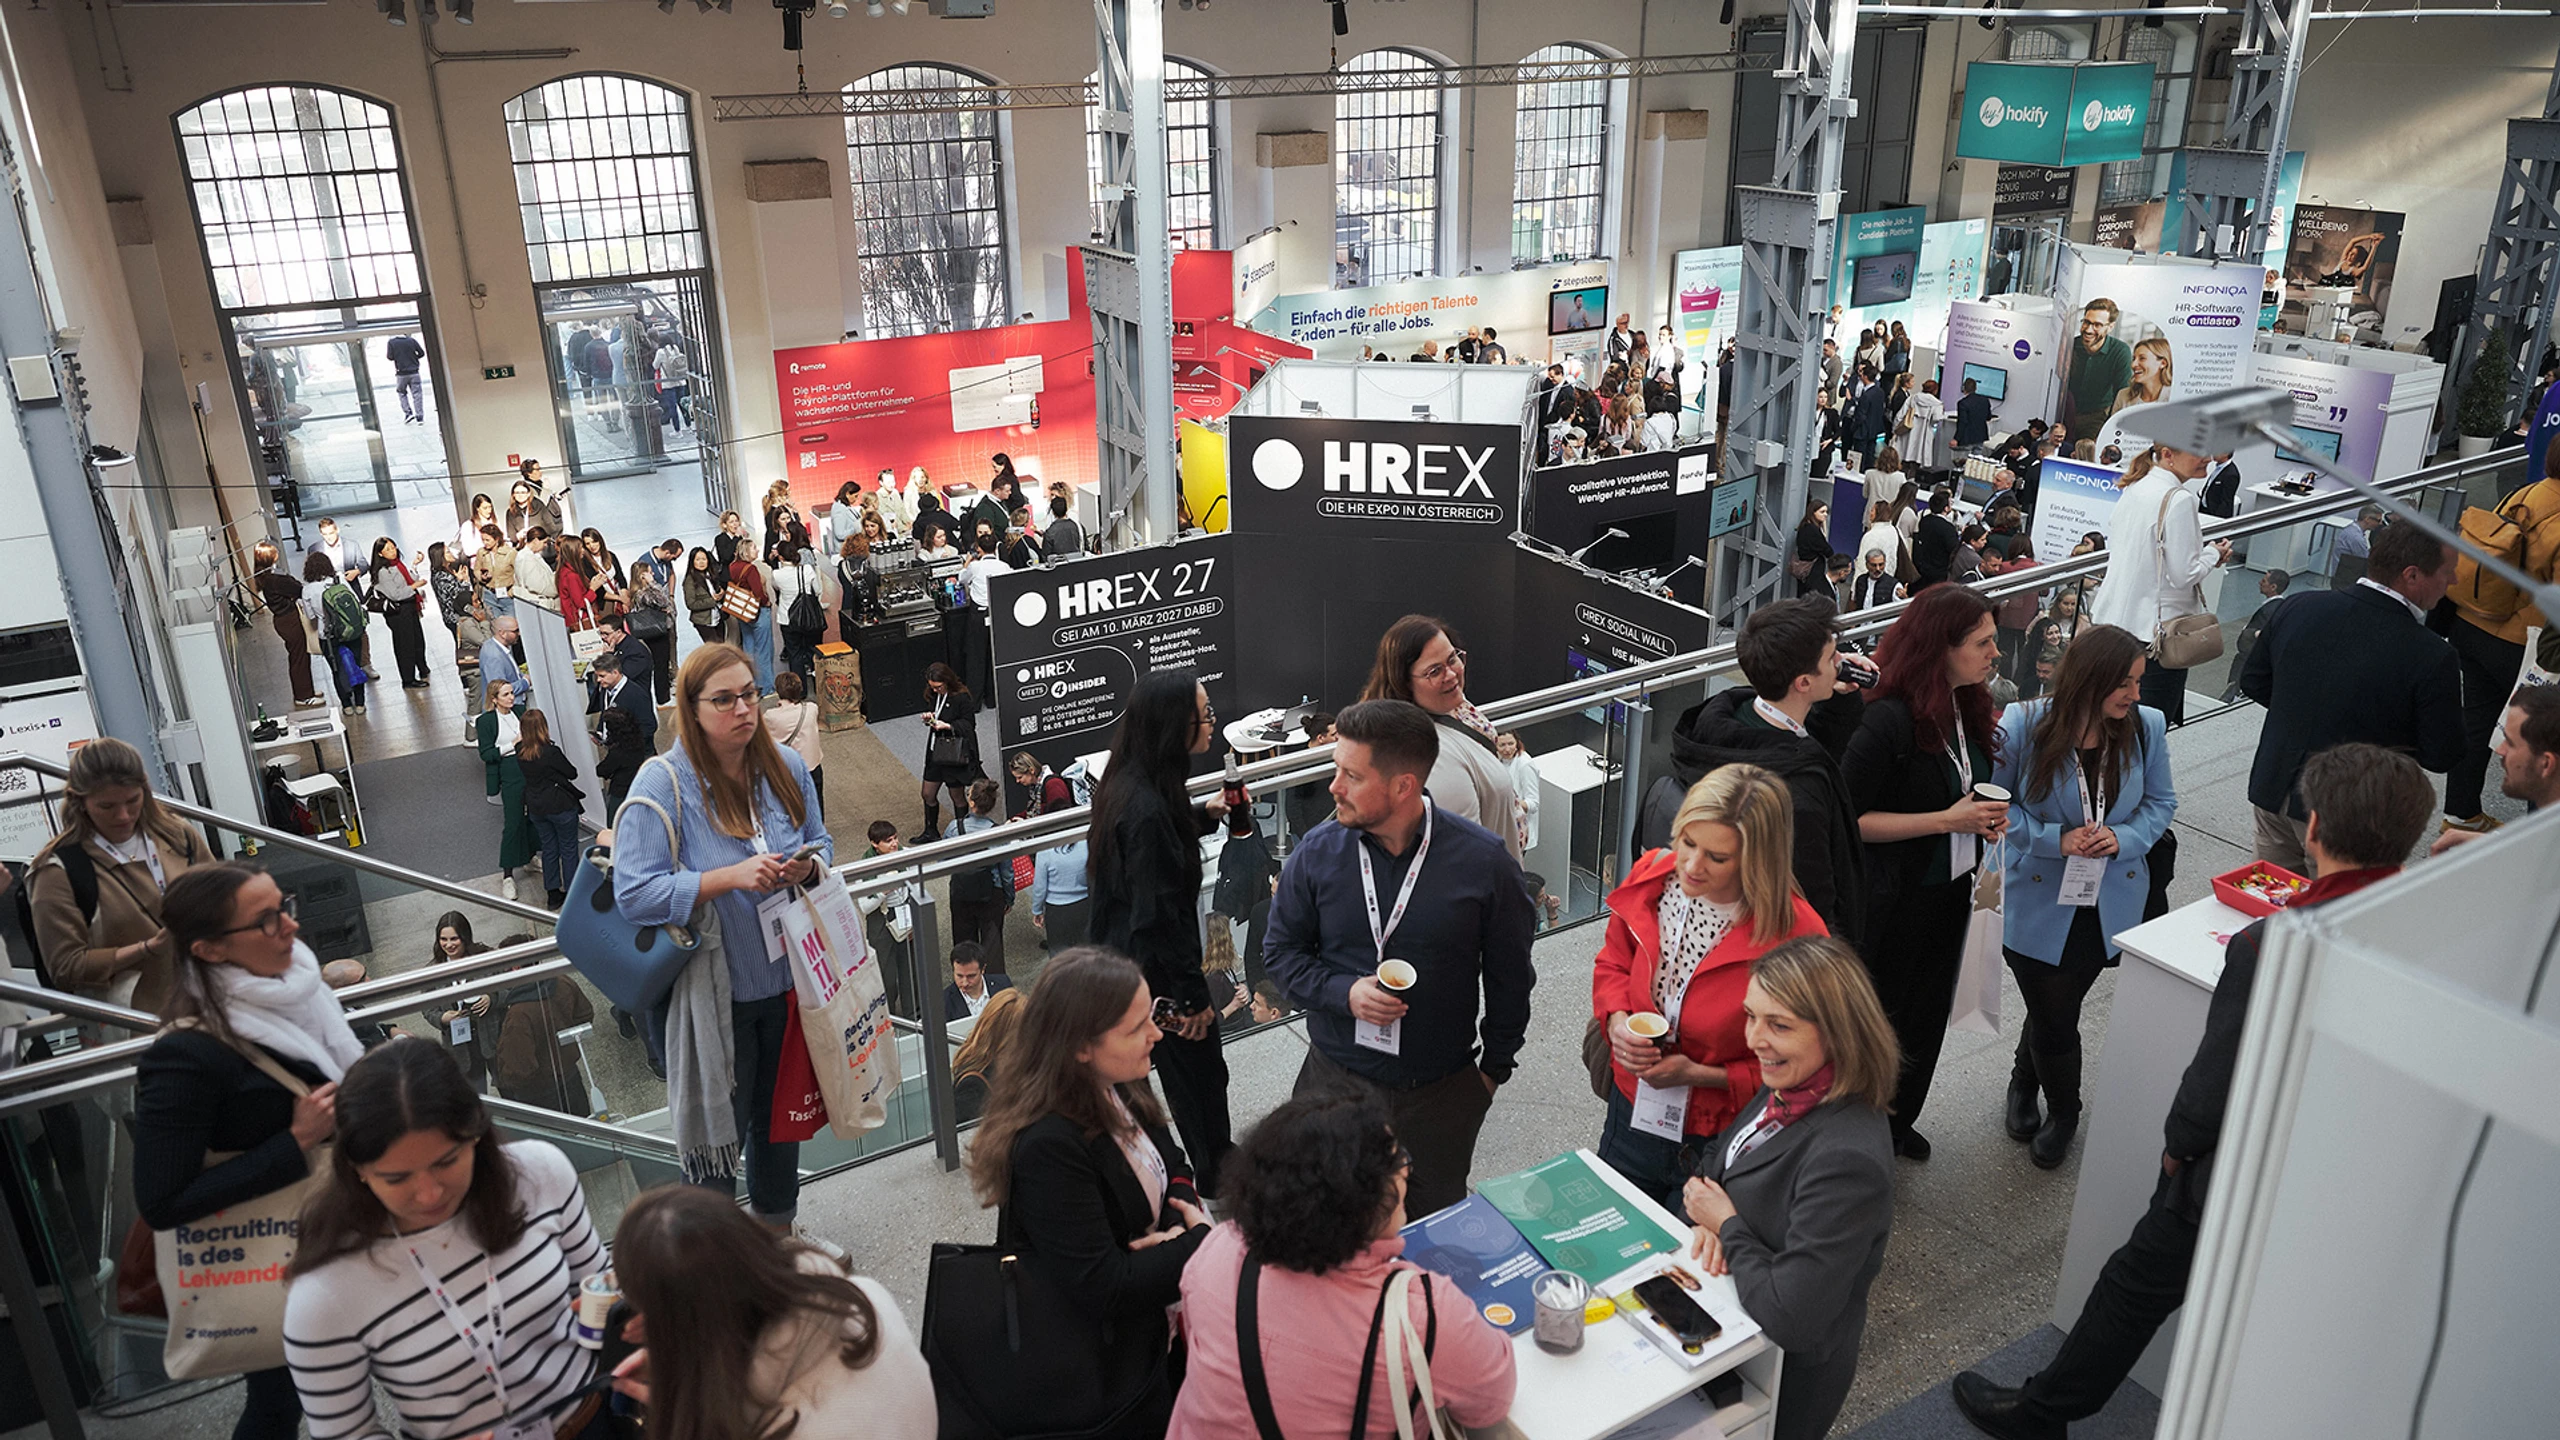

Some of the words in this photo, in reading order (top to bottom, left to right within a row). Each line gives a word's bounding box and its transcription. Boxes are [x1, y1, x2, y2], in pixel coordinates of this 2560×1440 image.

[2006, 105, 2049, 128] hokify
[2103, 104, 2136, 126] hokify
[2019, 169, 2041, 179] NICHT
[2100, 213, 2116, 222] MAKE
[2299, 210, 2325, 220] MAKE
[1862, 221, 1872, 229] Die
[1873, 218, 1892, 227] mobile
[2098, 220, 2134, 232] CORPORATE
[2298, 219, 2349, 232] WELLBEING
[1858, 231, 1888, 241] Candidate
[1889, 227, 1915, 236] Platform
[2096, 231, 2119, 241] HEALTH
[2297, 229, 2324, 239] WORK
[1250, 260, 1275, 283] stepstone
[1712, 261, 1741, 270] Performanc
[1563, 274, 1604, 286] stepstone
[2183, 285, 2248, 297] INFONIQA
[1291, 306, 1342, 326] Einfach
[1345, 305, 1366, 320] die
[1369, 297, 1429, 317] richtigen
[1431, 293, 1479, 309] Talente
[2175, 303, 2245, 314] HR-Software,
[1291, 326, 1336, 342] fnden
[1350, 319, 1371, 337] für
[1373, 317, 1396, 334] alle
[1398, 314, 1434, 331] Jobs.
[2168, 316, 2184, 325] die
[801, 363, 826, 372] remote
[793, 386, 809, 396] Die
[810, 384, 830, 393] HR-
[832, 381, 852, 391] und
[2267, 377, 2287, 385] macht
[2287, 380, 2313, 390] einfach
[2314, 385, 2333, 395] Spaß
[794, 388, 878, 407] Payroll-Plattform
[880, 387, 895, 396] für
[795, 403, 849, 417] wachsende
[851, 396, 915, 410] Unternehmen
[2305, 403, 2326, 412] habe.
[1323, 440, 1496, 498] HREX
[1568, 476, 1616, 494] Qualitative
[1617, 468, 1671, 486] Vorselektion.
[2054, 470, 2120, 492] INFONIQA
[1578, 491, 1614, 505] Weniger
[1614, 482, 1670, 499] HR-Aufwand.
[1325, 502, 1344, 514] DIE
[1348, 503, 1365, 515] HR
[1367, 503, 1399, 516] EXPO
[1402, 505, 1416, 516] IN
[1418, 503, 1494, 519] ÖSTERREICH
[2050, 503, 2061, 511] Ein
[2062, 506, 2086, 517] Auszug
[2048, 514, 2074, 522] unserer
[1058, 568, 1162, 620] HREX
[1171, 557, 1216, 598] 27
[1060, 630, 1079, 643] SEI
[1081, 626, 1100, 639] AM
[1103, 622, 1119, 634] 10.
[1121, 613, 1154, 630] MÄRZ
[1156, 609, 1182, 624] 2027
[1184, 602, 1216, 618] DABEI
[1149, 635, 1161, 644] als
[1162, 627, 1201, 641] Aussteller,
[1582, 609, 1606, 627] HREX
[1606, 619, 1640, 642] SOCIAL
[1641, 632, 1668, 652] WALL
[1150, 644, 1217, 664] Masterclass-Host,
[1611, 646, 1628, 661] USE
[1034, 658, 1075, 680] HREX
[1021, 686, 1044, 696] MEETS
[1068, 676, 1107, 692] INSIDER
[1042, 706, 1052, 714] DIE
[1053, 701, 1077, 712] ONLINE
[1078, 693, 1115, 706] KONFERENZ
[1042, 714, 1055, 723] FÜR
[1056, 706, 1095, 720] ÖSTERREICH
[9, 720, 47, 735] Lexis+
[1064, 719, 1076, 727] BIS
[2, 821, 36, 833] Fragen
[846, 1042, 856, 1055] is
[176, 1216, 301, 1245] Recruiting
[177, 1248, 194, 1266] is
[200, 1246, 245, 1265] des
[178, 1262, 288, 1288] Leiwands
[198, 1326, 258, 1341] stepstone
